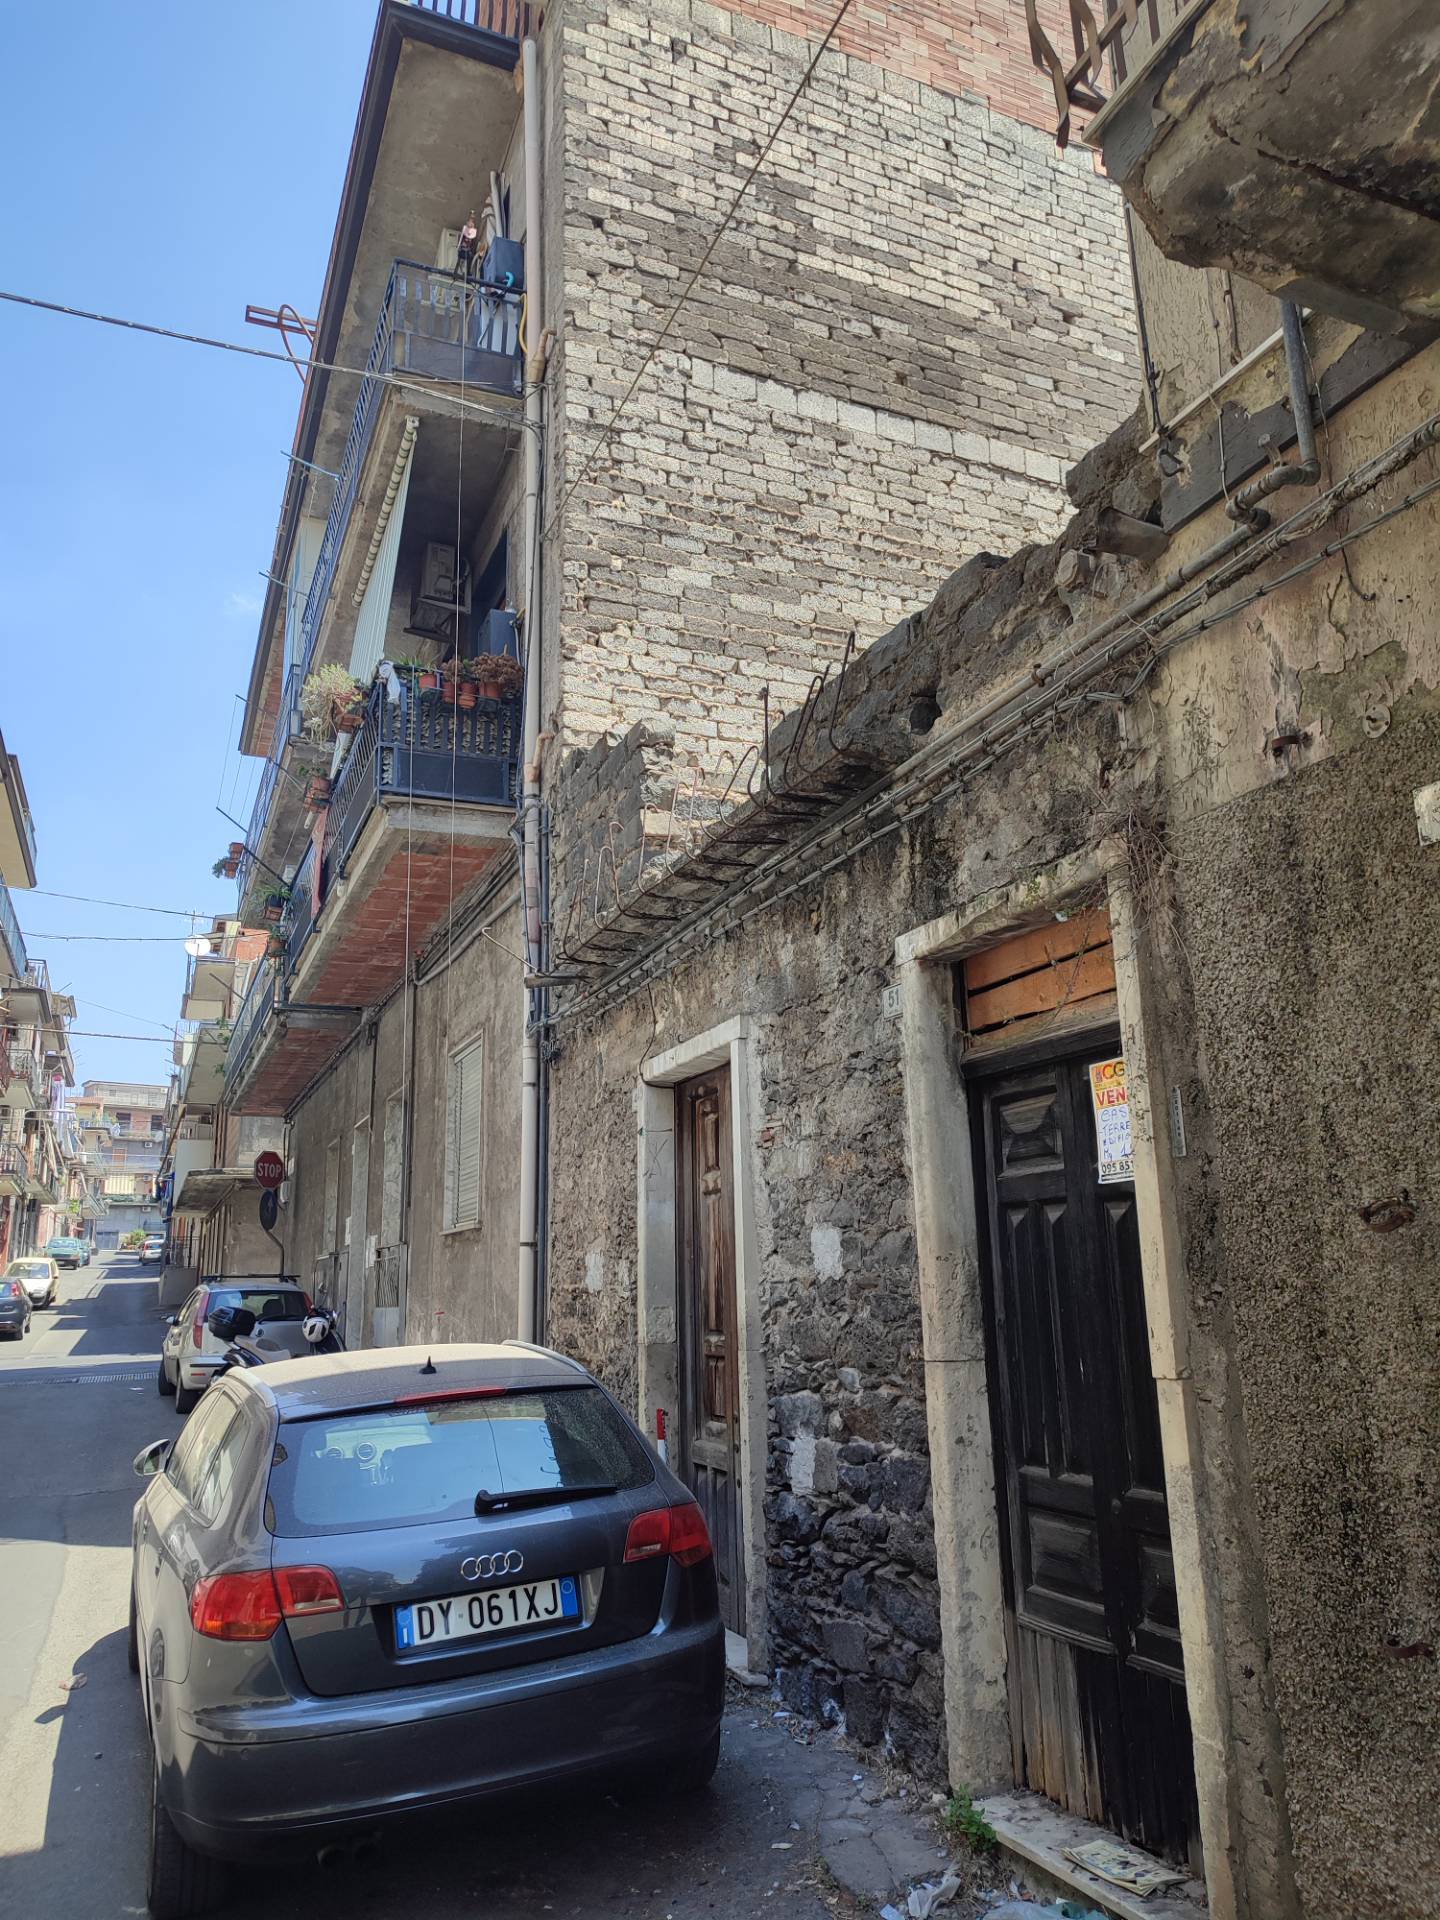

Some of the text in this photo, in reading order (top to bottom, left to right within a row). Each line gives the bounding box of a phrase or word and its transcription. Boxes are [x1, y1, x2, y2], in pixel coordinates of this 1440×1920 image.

[888, 987, 899, 1008] 51
[1096, 1087, 1129, 1106] VEN
[257, 1162, 282, 1178] STOP
[1101, 1163, 1118, 1173] 095
[417, 1582, 559, 1641] DY 061XJ
